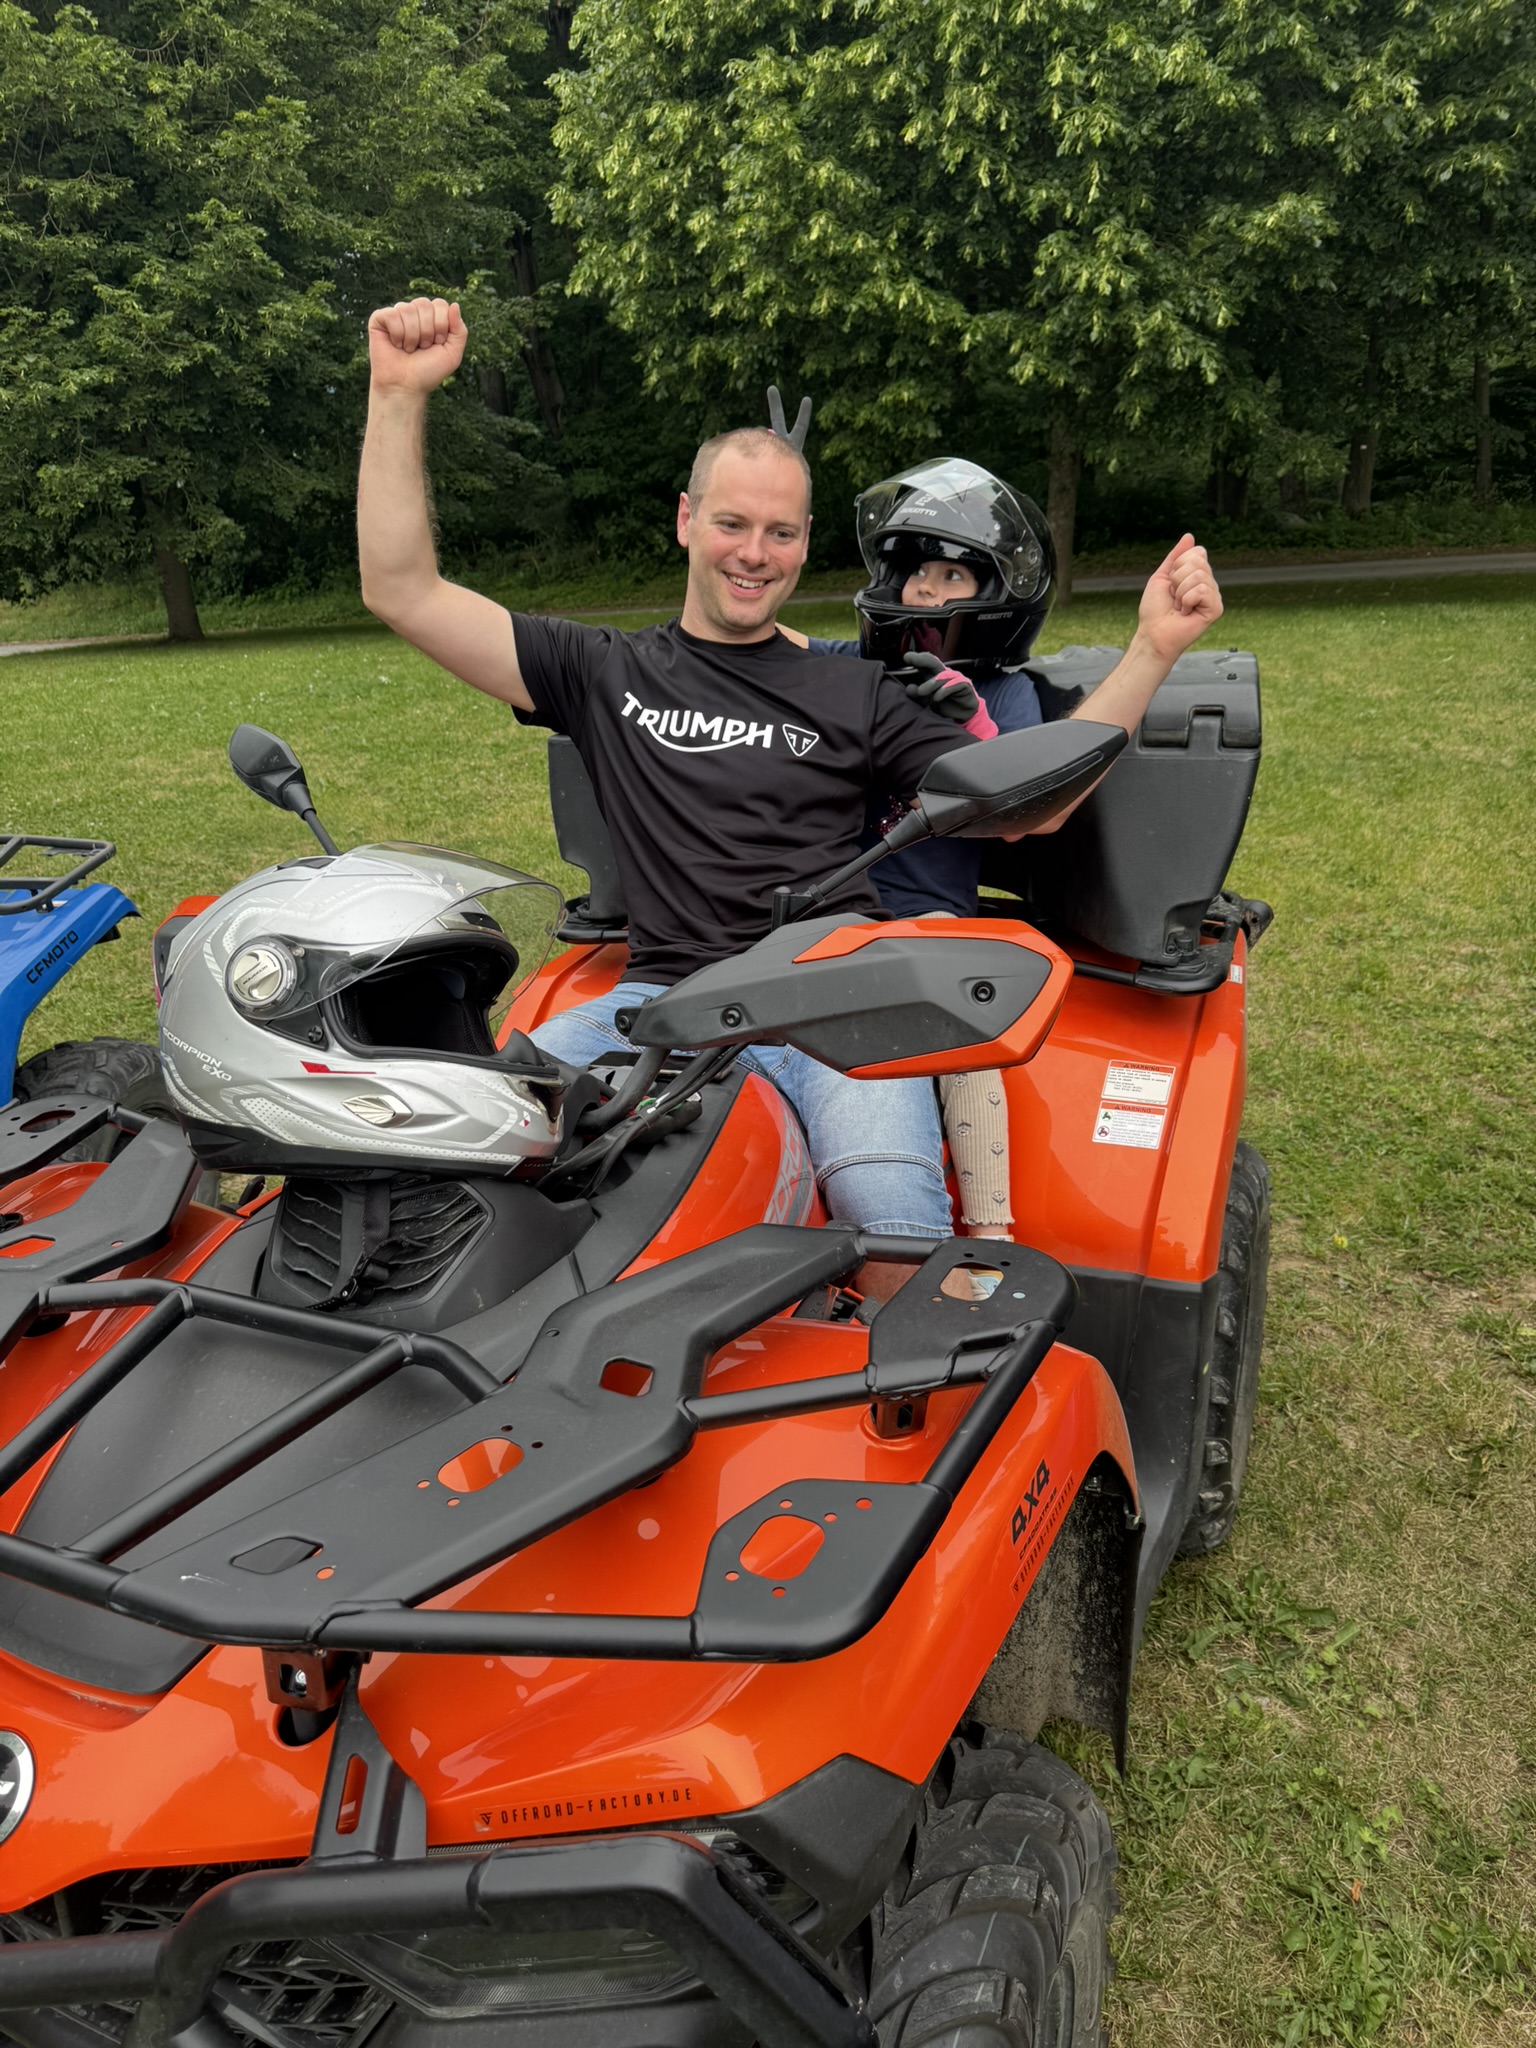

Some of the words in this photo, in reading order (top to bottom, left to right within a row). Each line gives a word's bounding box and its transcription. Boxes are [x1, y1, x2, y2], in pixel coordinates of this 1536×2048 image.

[621, 691, 774, 752] TRIUMPH
[26, 930, 79, 985] CFMOTO
[162, 1026, 222, 1068] SCORPION
[202, 1063, 232, 1081] EXO
[1130, 1063, 1160, 1072] WARNING
[1121, 1104, 1152, 1113] WARNING
[501, 1788, 692, 1824] OFFROAD-FACTORY.DE
